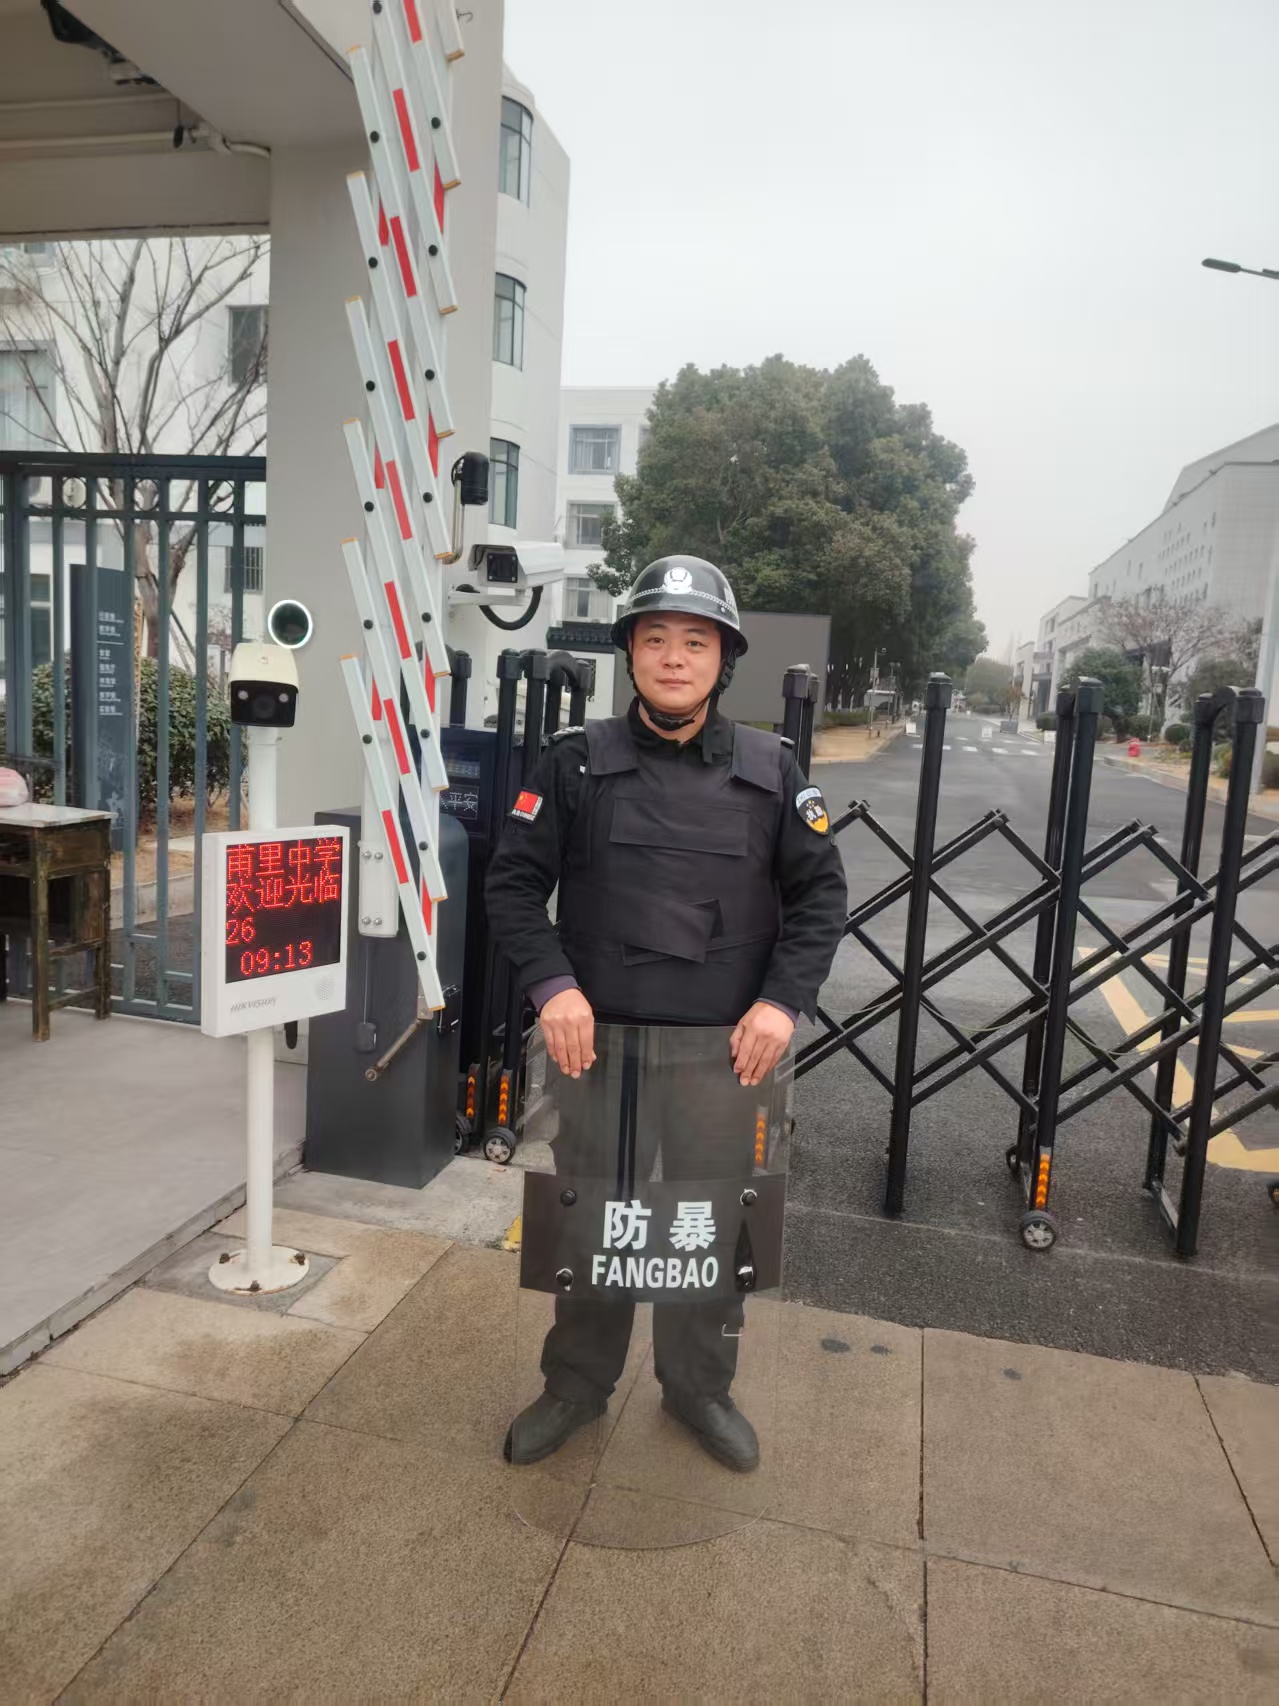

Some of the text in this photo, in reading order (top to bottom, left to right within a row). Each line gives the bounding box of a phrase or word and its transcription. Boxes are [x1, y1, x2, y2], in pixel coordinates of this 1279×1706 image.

[440, 791, 477, 813] 平安
[226, 837, 340, 880] 甫里中学
[226, 868, 340, 914] 欢迎光临
[226, 917, 256, 945] 26
[240, 941, 313, 975] 09:13
[603, 1200, 716, 1251] 防暴
[591, 1254, 719, 1289] FANGBAO
